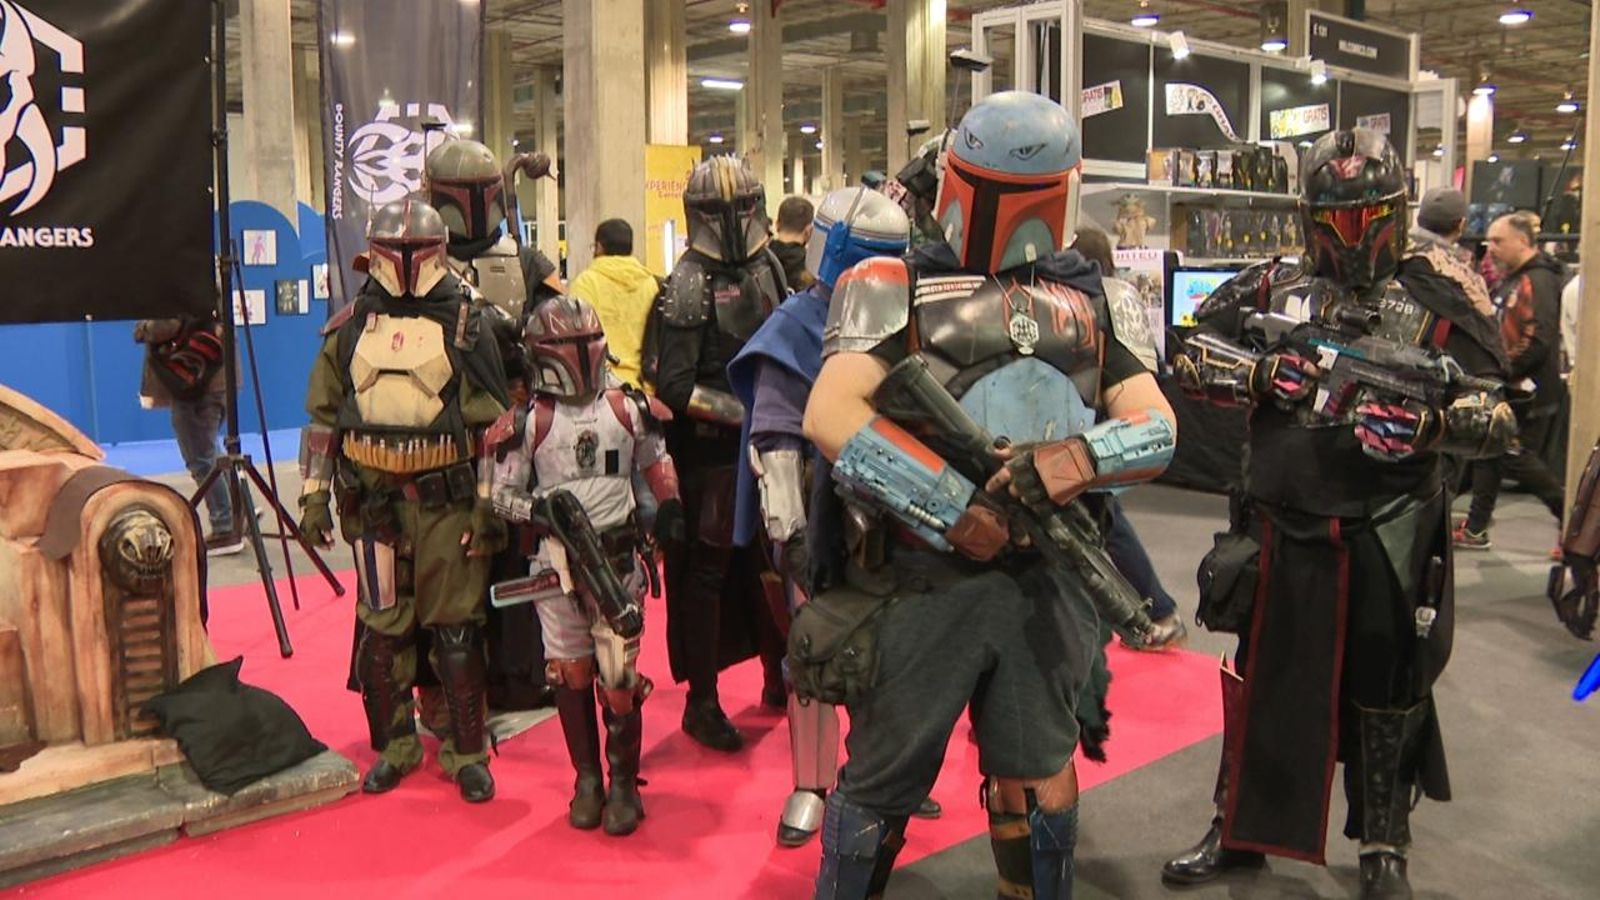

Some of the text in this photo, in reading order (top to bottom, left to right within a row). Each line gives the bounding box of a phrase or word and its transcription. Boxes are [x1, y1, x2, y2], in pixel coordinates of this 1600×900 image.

[332, 103, 344, 220] BOUNTY RANGERS
[0, 227, 94, 248] ANGERS
